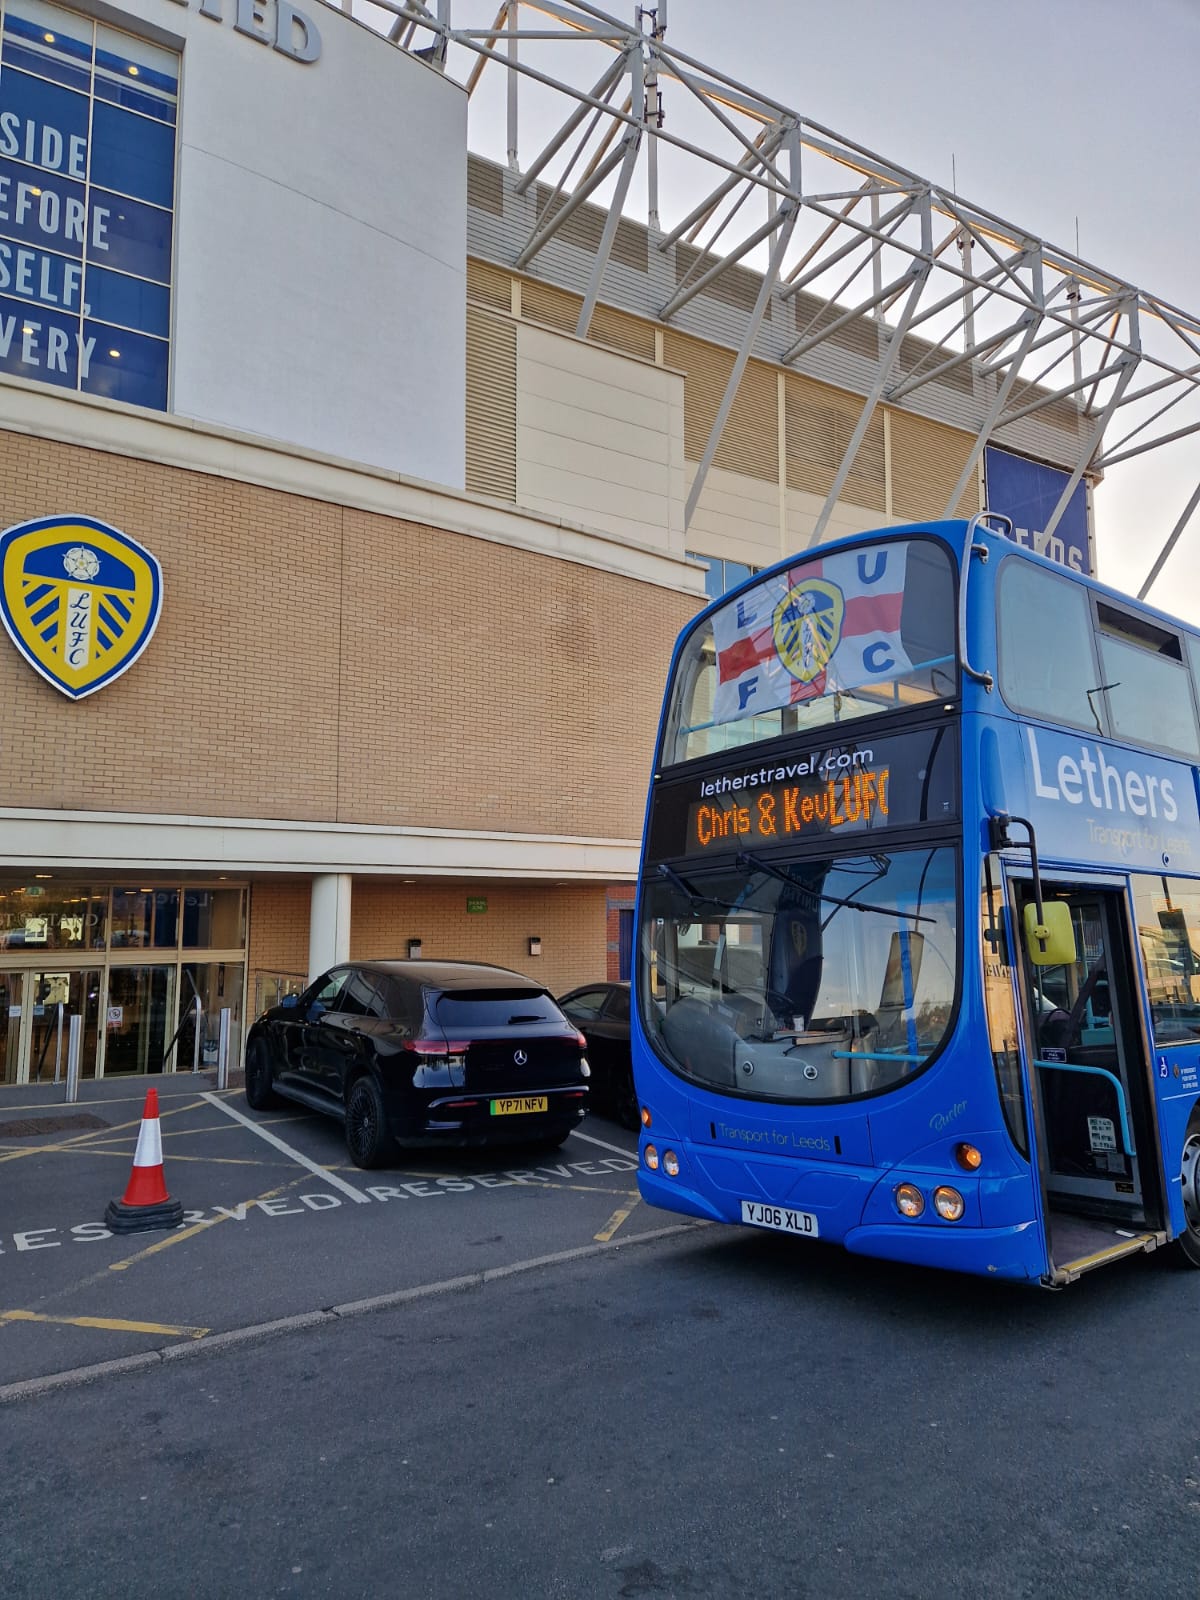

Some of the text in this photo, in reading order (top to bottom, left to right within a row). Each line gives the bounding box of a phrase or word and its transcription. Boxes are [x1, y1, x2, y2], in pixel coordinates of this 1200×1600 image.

[737, 551, 888, 629] L U
[738, 641, 895, 710] F C
[1027, 727, 1178, 821] Lethers
[697, 804, 750, 845] Chris
[758, 793, 777, 836] &
[38, 913, 99, 927] STAND
[499, 1097, 544, 1113] YP71 NFV
[719, 1123, 831, 1151] Transport for Leeds
[365, 1158, 639, 1202] RESERVED
[747, 1204, 813, 1233] YJ06 XLD
